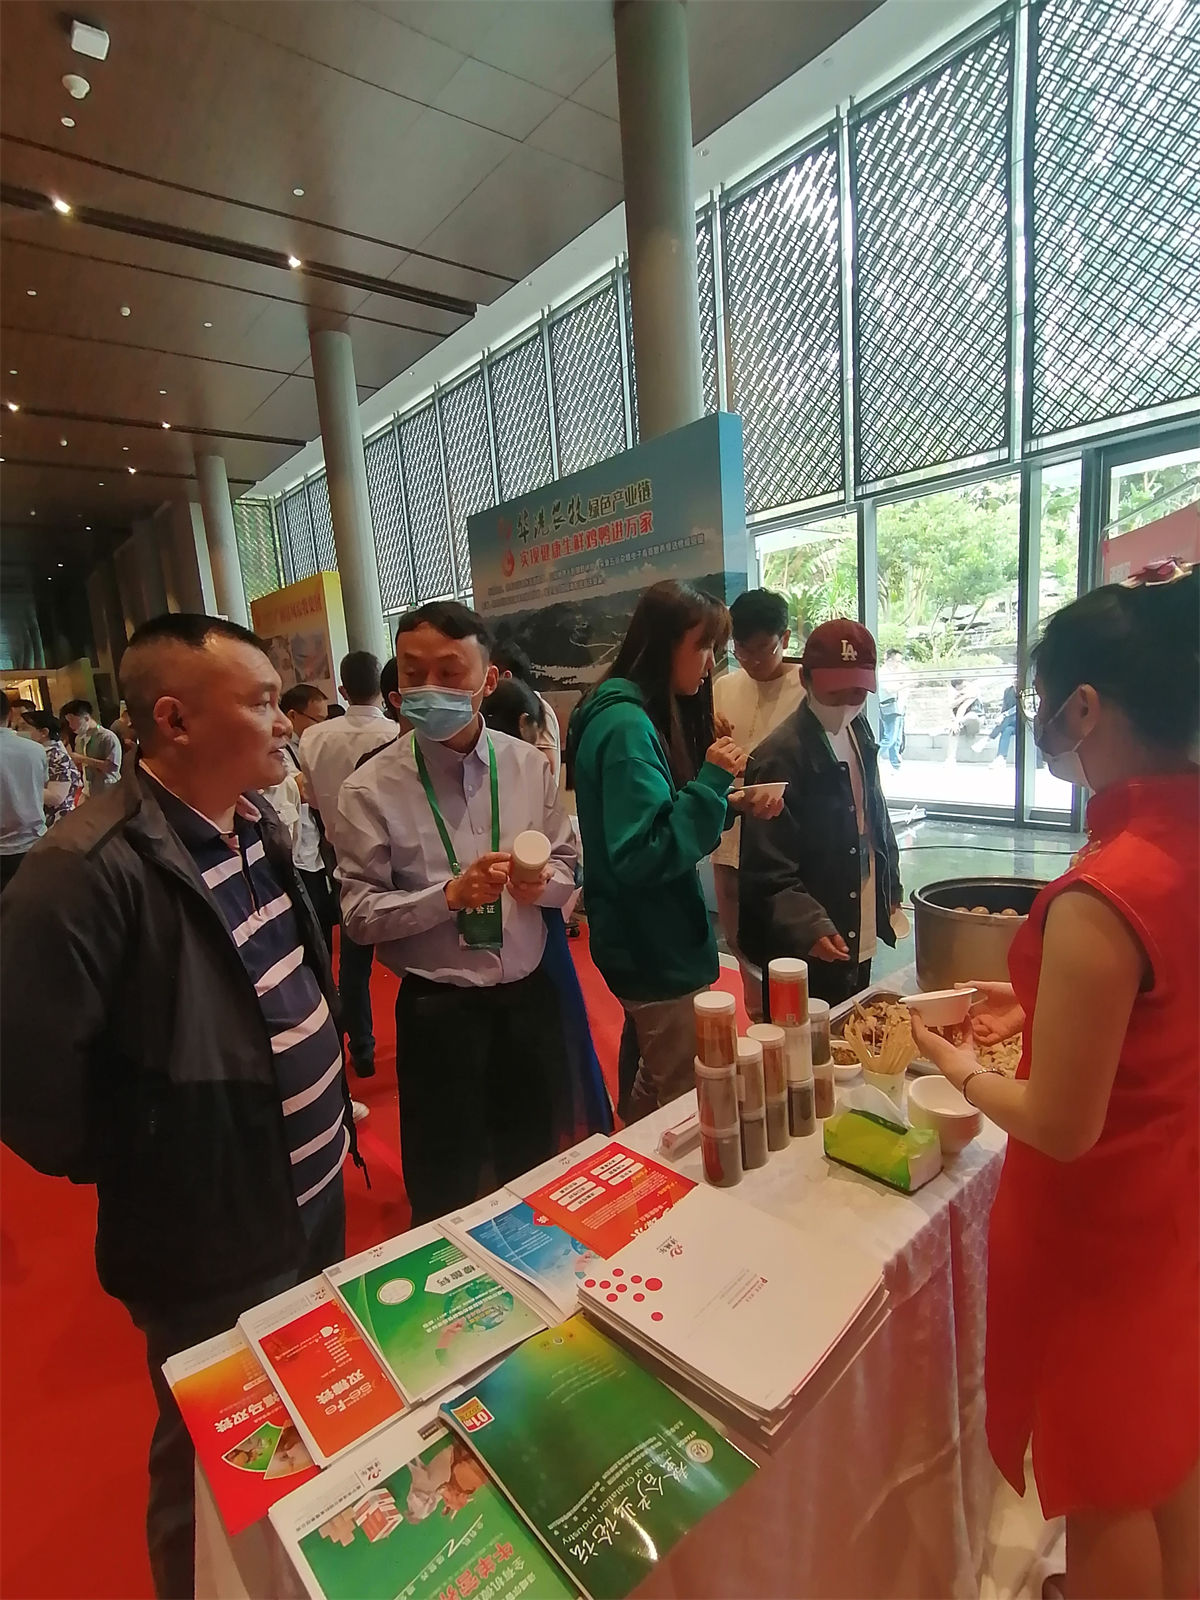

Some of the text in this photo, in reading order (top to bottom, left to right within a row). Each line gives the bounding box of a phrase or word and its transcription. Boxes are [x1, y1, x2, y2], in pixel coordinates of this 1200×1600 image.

[520, 511, 653, 568] 实现健康生鲜鸡鸭进万家
[841, 639, 858, 662] LA
[643, 1449, 671, 1472] Journal
[569, 1457, 688, 1565] 螯合产业论坛
[597, 1476, 635, 1513] Chelation
[562, 1513, 598, 1545] Industry
